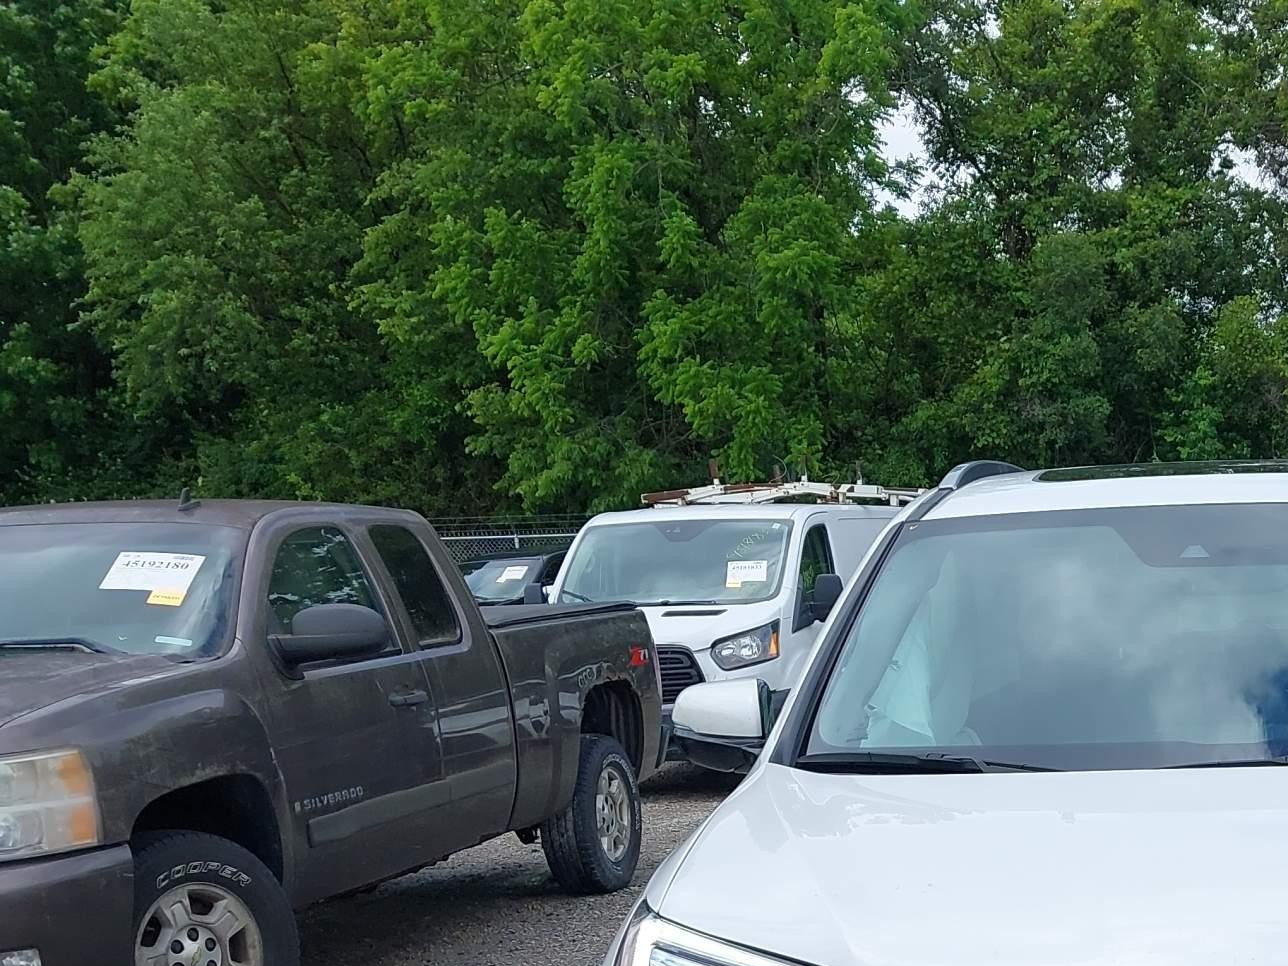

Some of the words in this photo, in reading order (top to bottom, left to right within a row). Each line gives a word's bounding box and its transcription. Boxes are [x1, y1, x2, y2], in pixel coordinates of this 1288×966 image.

[121, 560, 190, 570] 45192180
[303, 785, 364, 809] SILVERADO
[156, 860, 252, 889] COOPER
